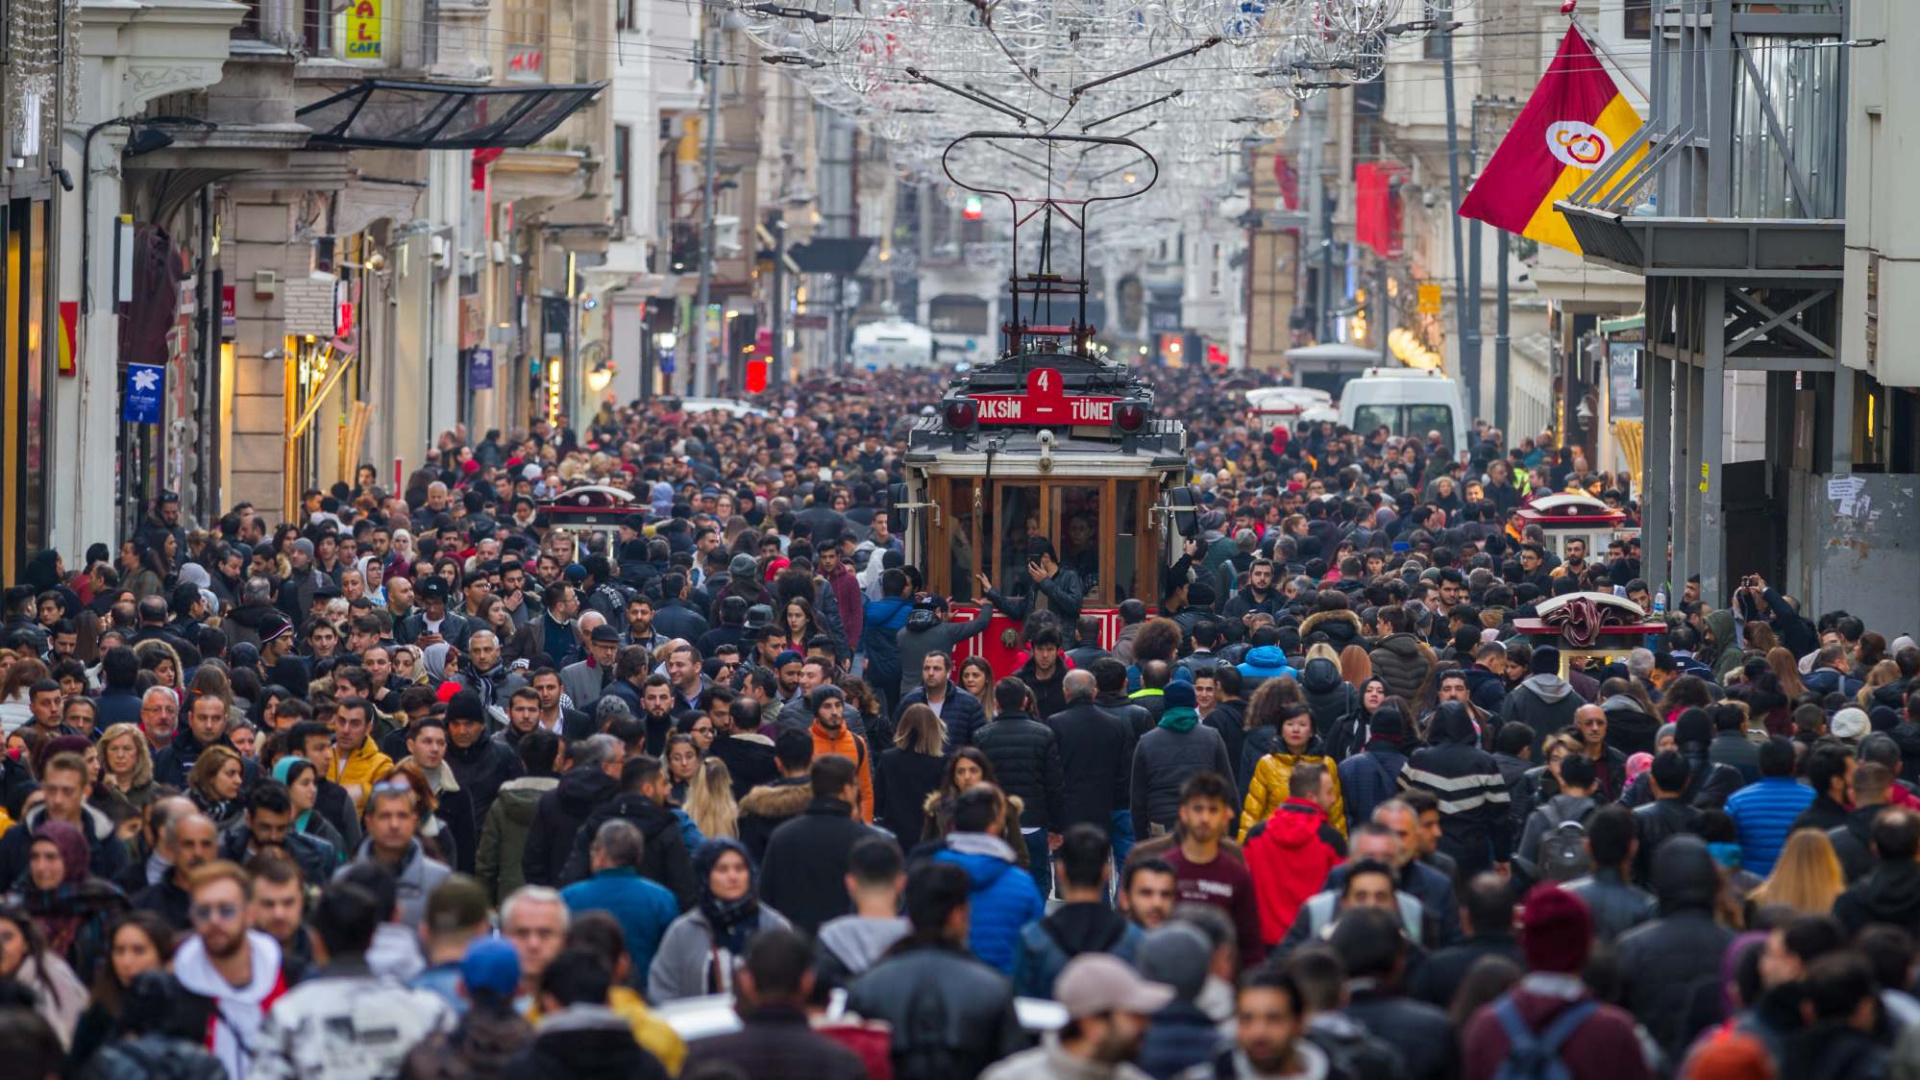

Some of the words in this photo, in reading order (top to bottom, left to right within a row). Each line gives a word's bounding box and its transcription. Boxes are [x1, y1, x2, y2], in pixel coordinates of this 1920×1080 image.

[349, 42, 381, 54] CAFE
[1038, 370, 1048, 391] 4
[977, 397, 1021, 418] AKSİM
